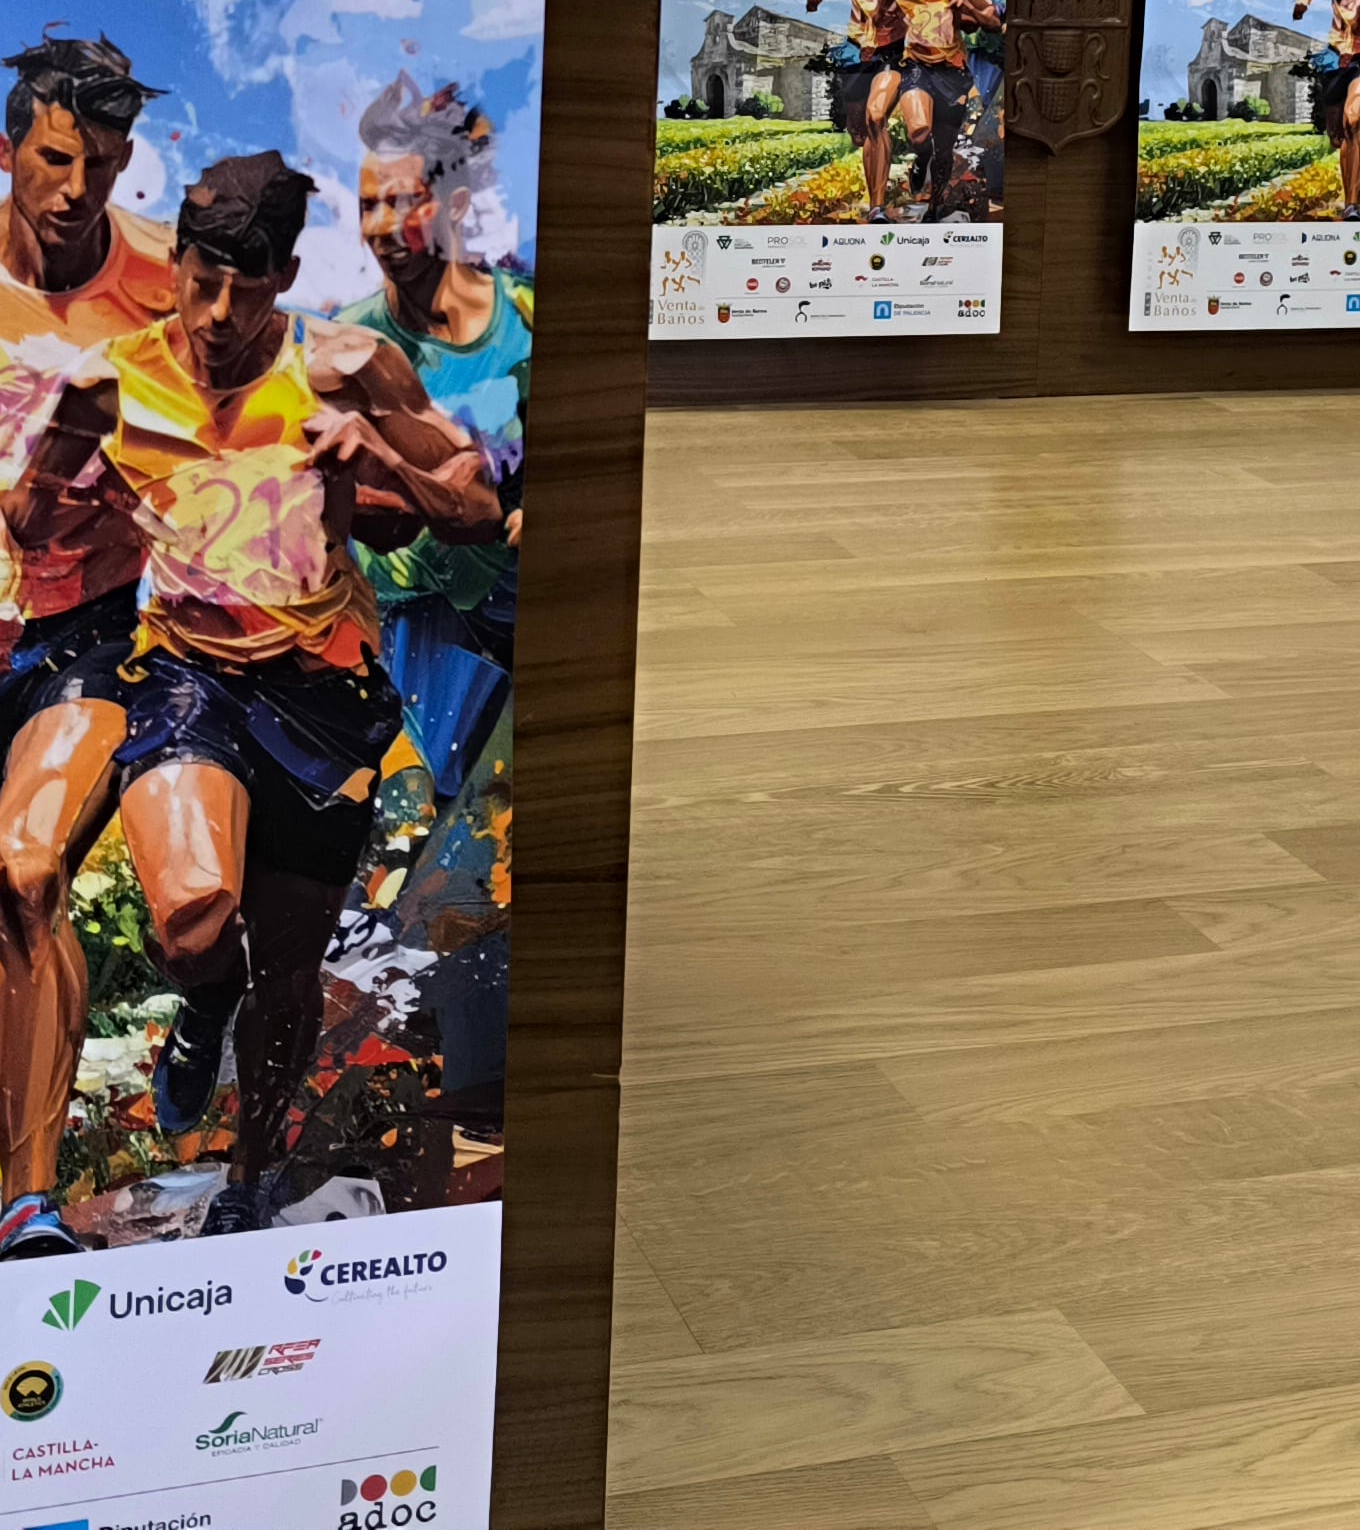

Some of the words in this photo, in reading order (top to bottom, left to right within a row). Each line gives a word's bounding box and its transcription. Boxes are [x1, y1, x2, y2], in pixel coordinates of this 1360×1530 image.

[833, 237, 866, 246] AQUONA
[896, 236, 930, 246] Unicaja
[952, 235, 988, 243] CEREALTO
[1154, 292, 1189, 304] Venta
[657, 299, 697, 311] Venta
[1154, 304, 1197, 317] Baños
[657, 312, 705, 325] Baños
[320, 1250, 448, 1286] CEREALTO
[109, 1280, 234, 1322] Unicaja
[195, 1418, 320, 1451] SoriaNatural
[13, 1440, 99, 1461] CASTILLA-
[12, 1468, 33, 1481] LA
[39, 1456, 115, 1478] MANCHA
